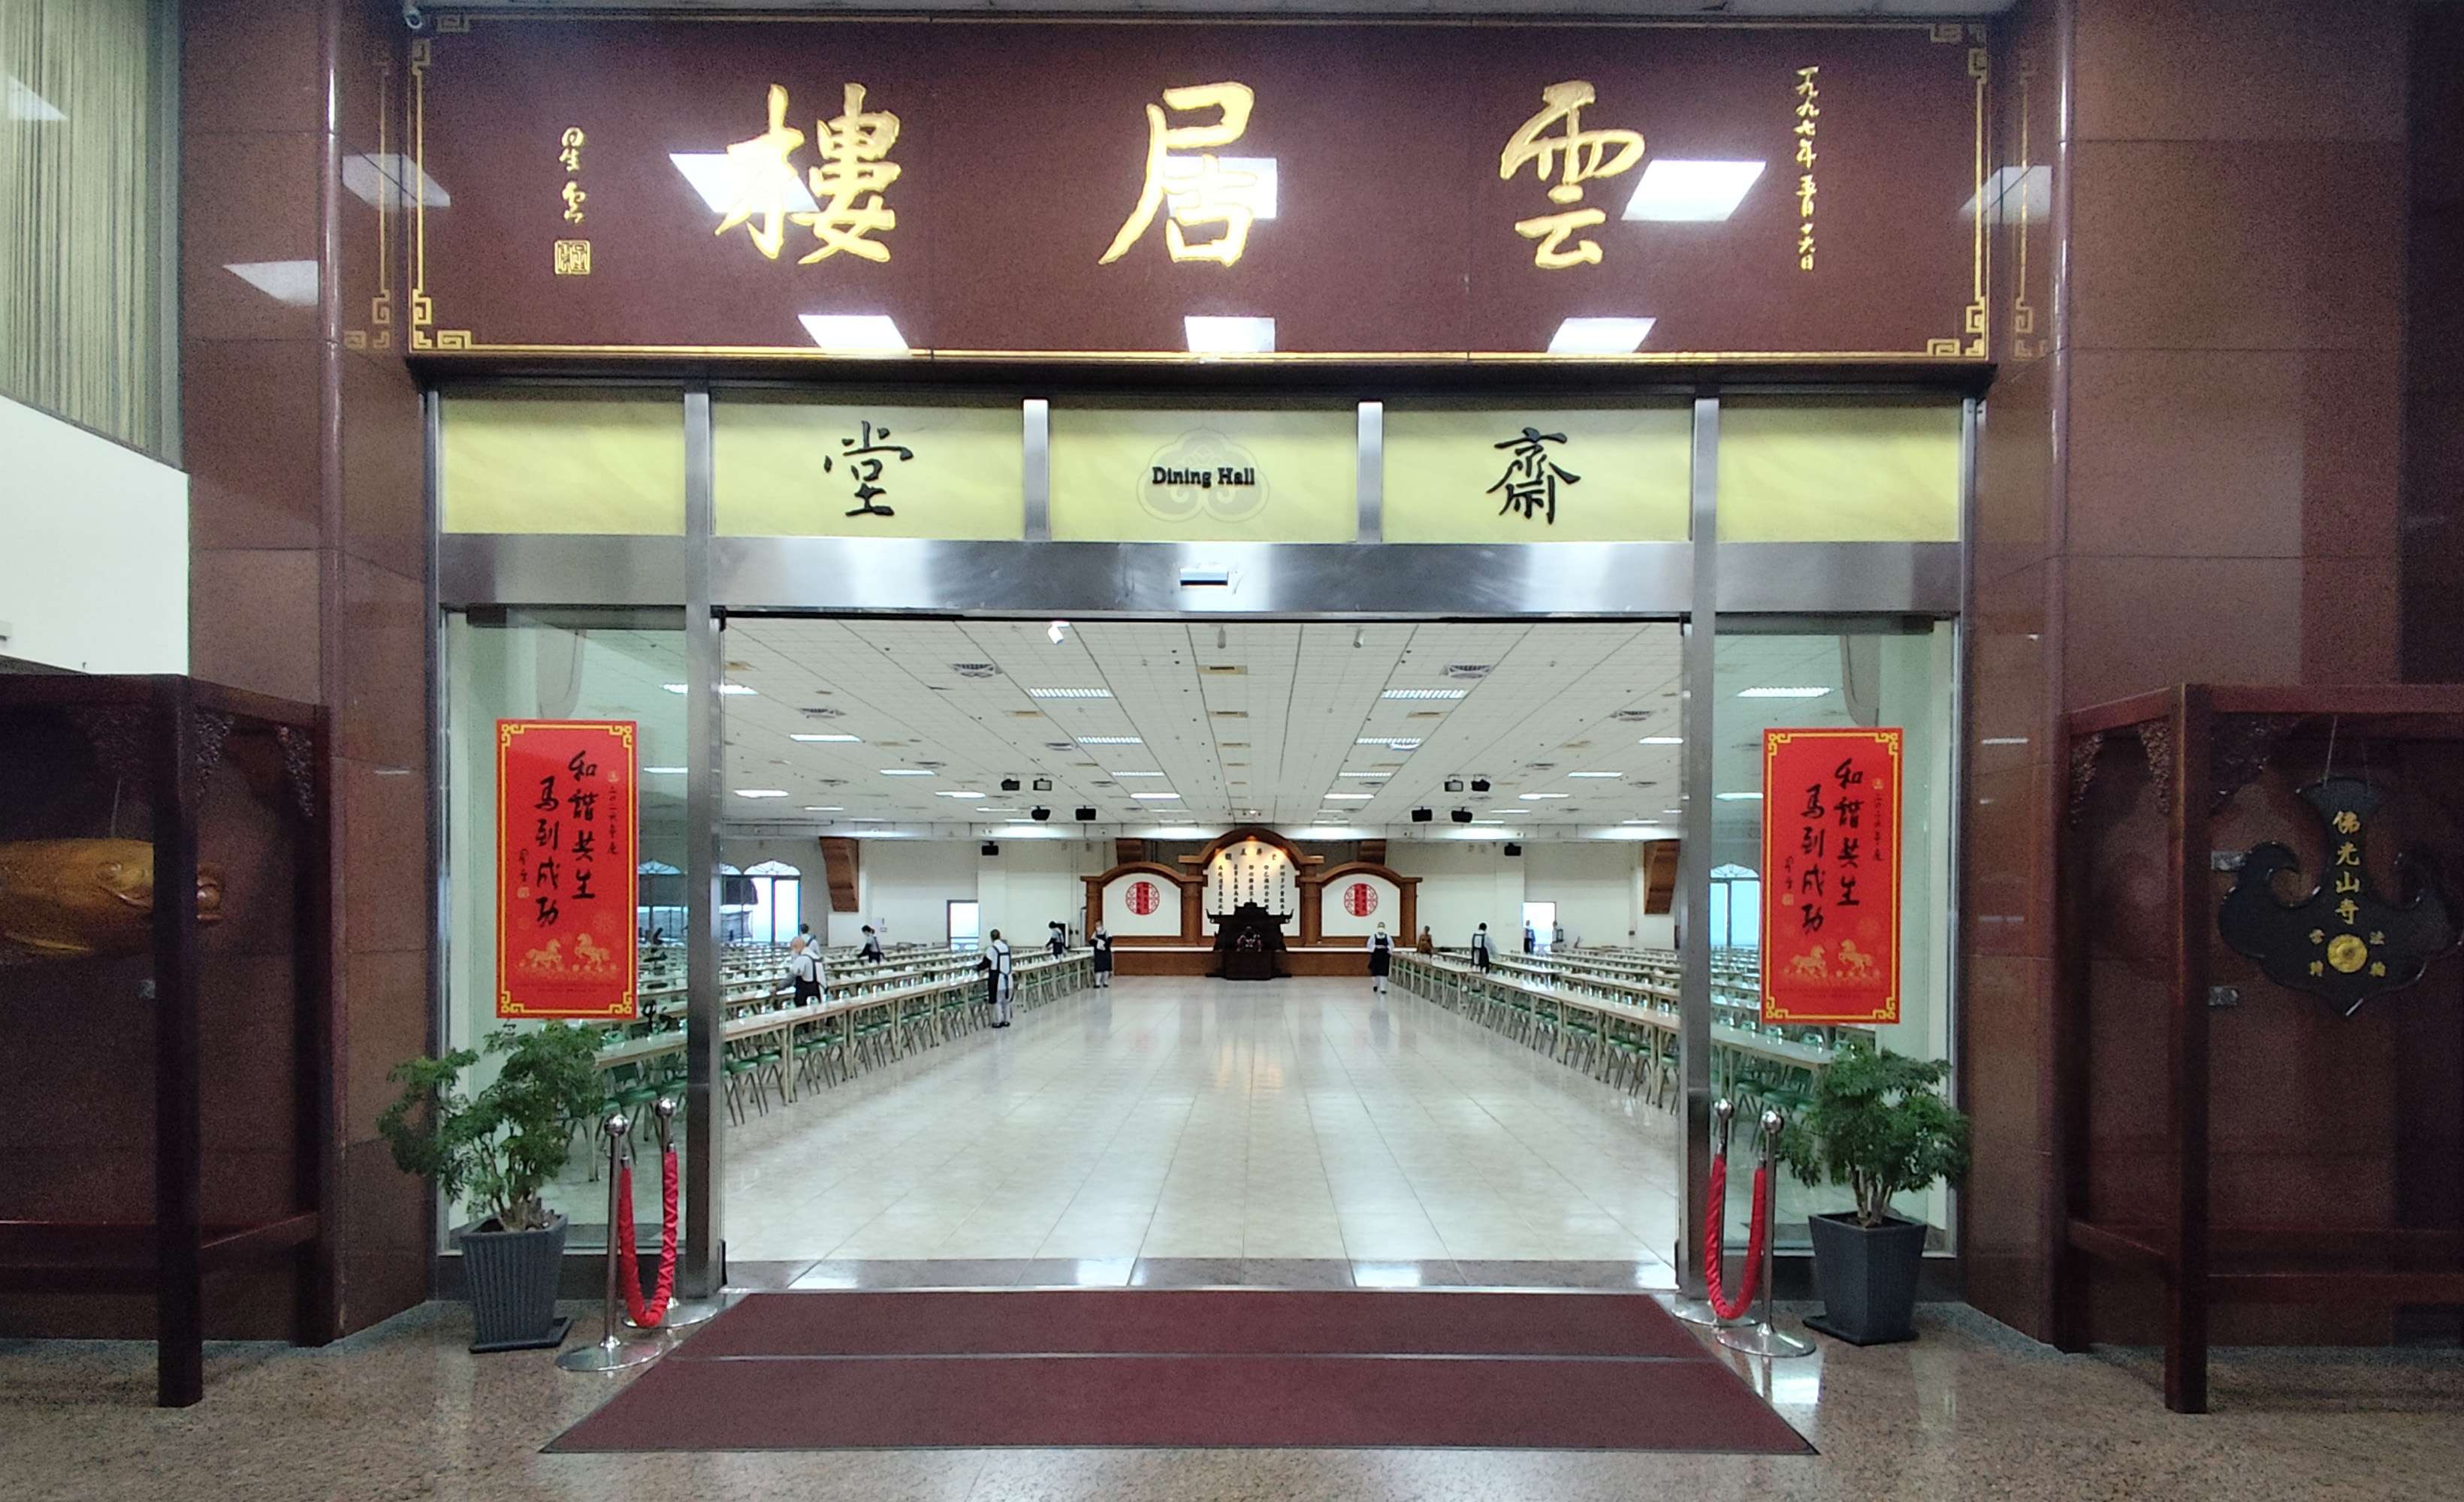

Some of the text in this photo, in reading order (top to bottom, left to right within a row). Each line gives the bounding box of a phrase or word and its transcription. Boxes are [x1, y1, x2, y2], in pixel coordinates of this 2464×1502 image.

[1152, 466, 1255, 489] Dining Hall
[534, 775, 560, 928] 馬到成功
[566, 749, 598, 900] 和諧共生
[1800, 783, 1825, 936] 馬到成功
[1833, 757, 1865, 907] 和諧共生
[2332, 810, 2361, 925] 佛光山寺
